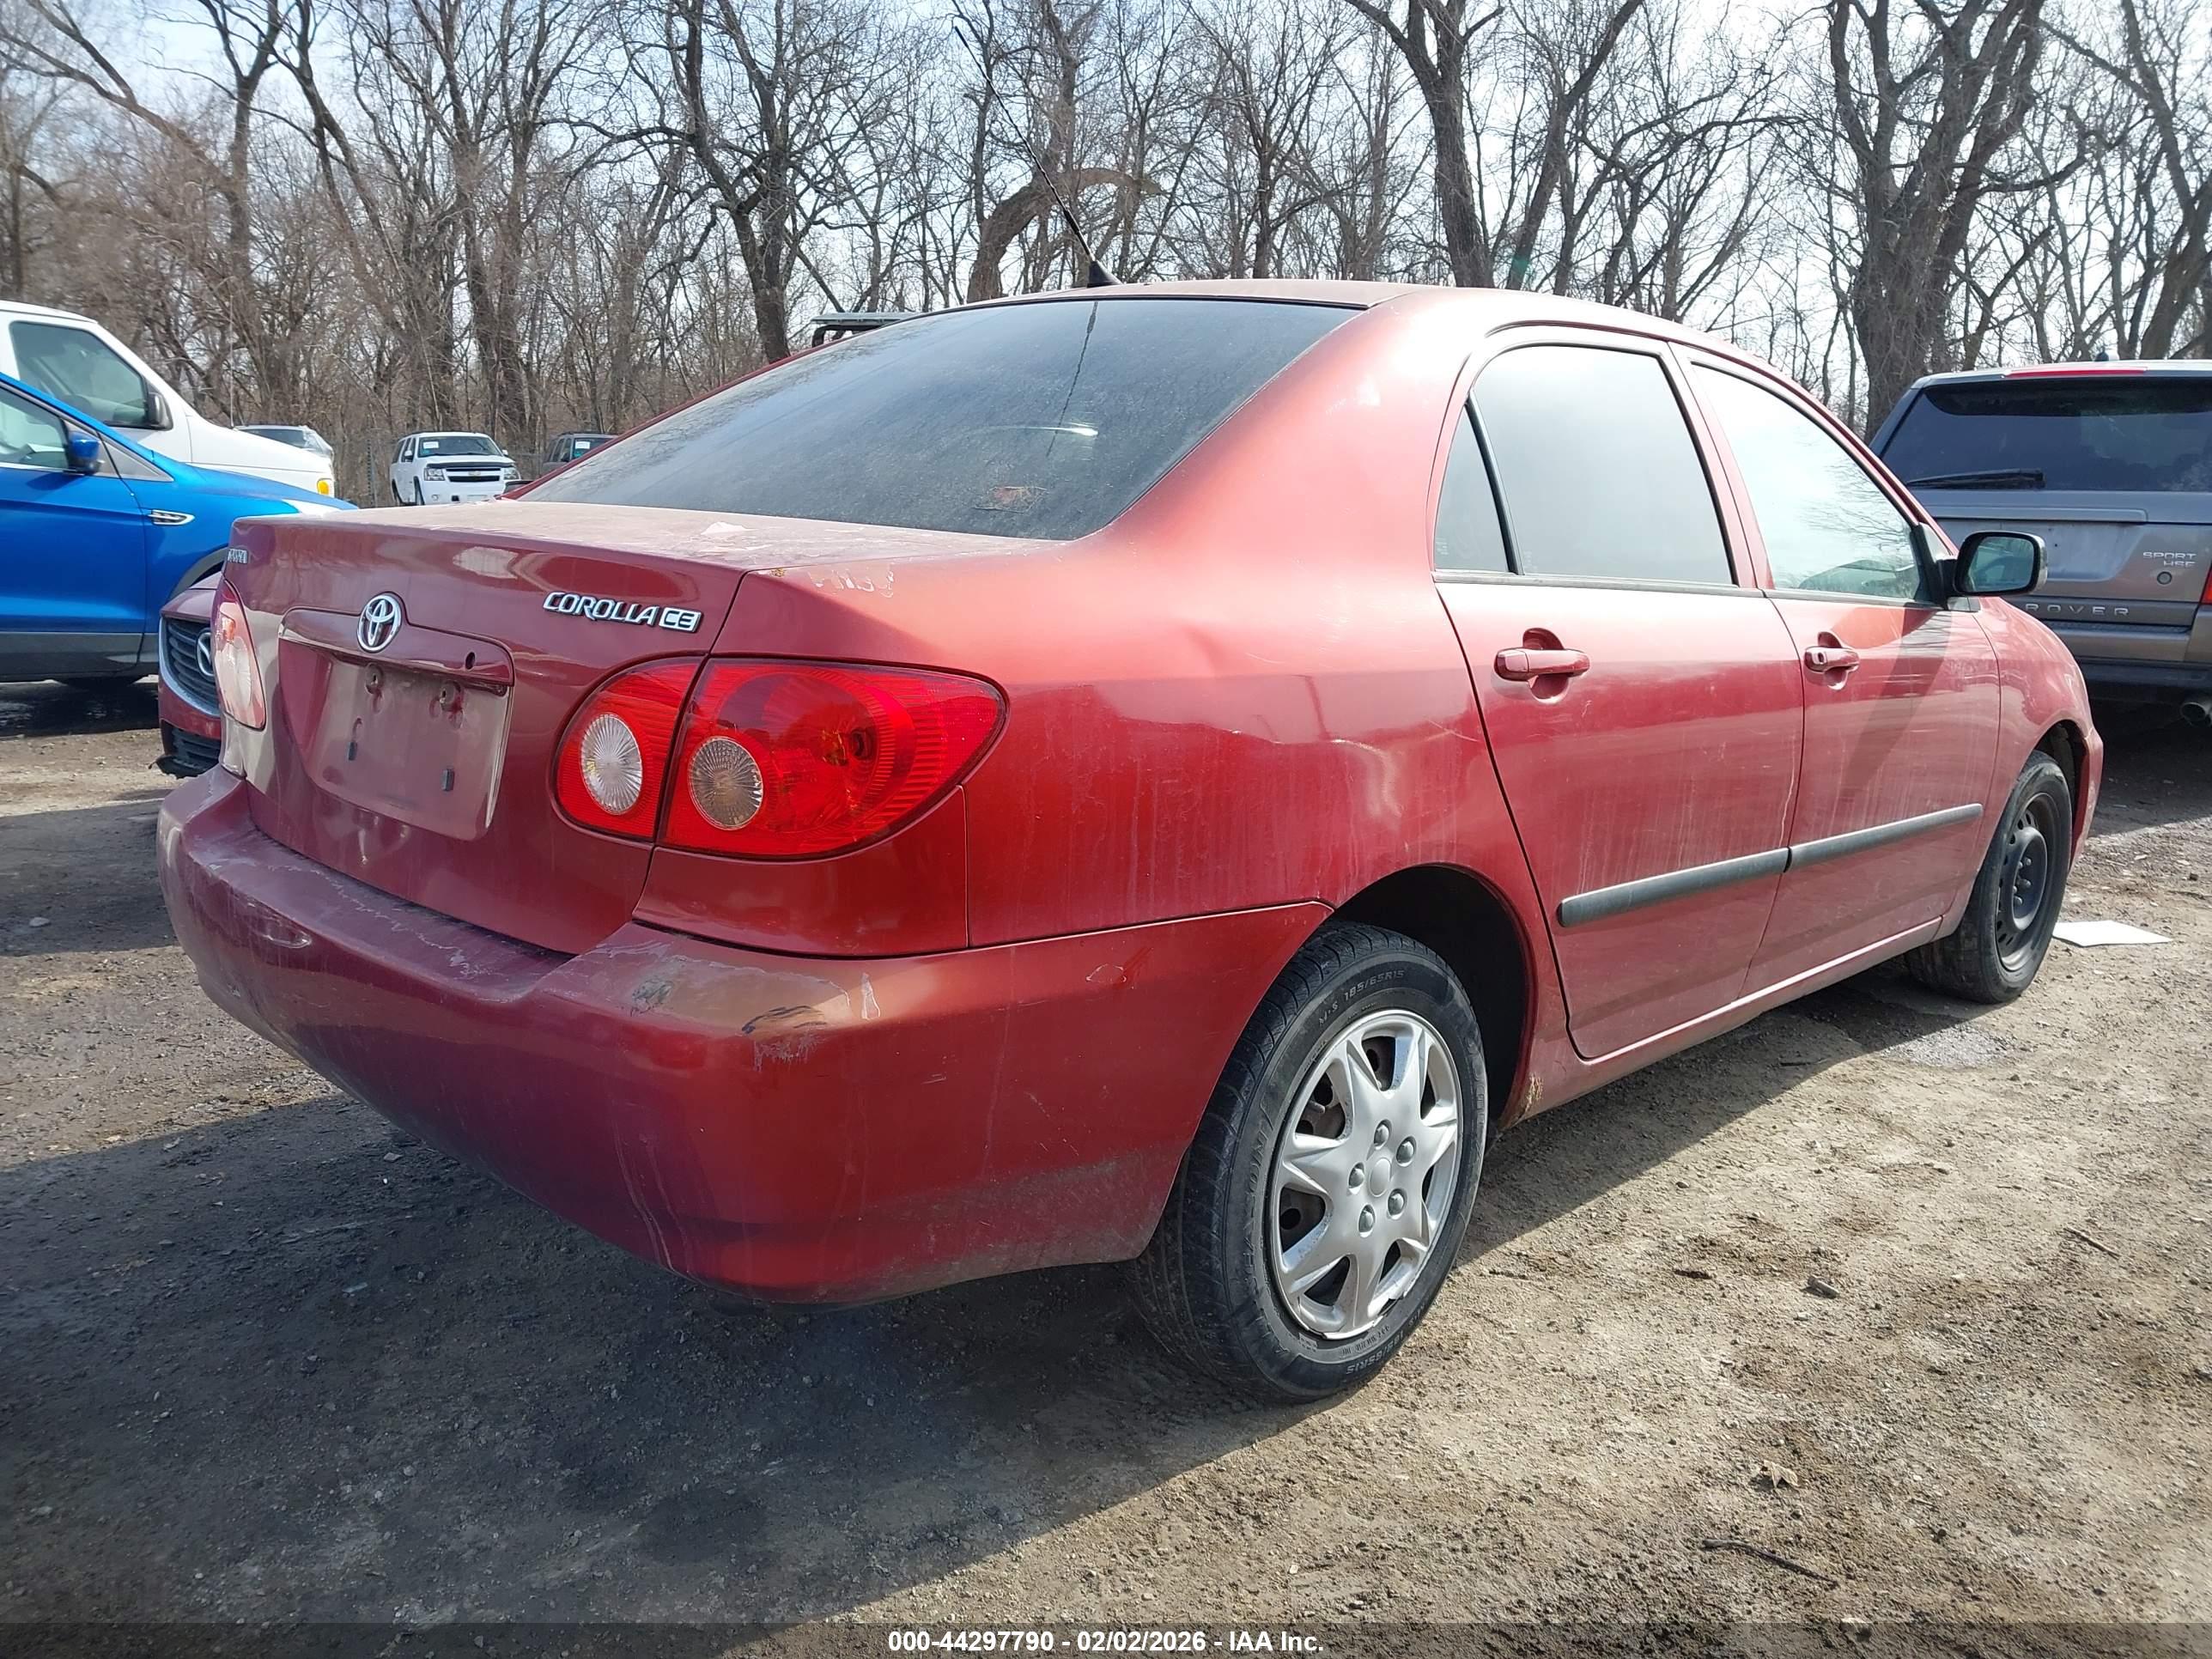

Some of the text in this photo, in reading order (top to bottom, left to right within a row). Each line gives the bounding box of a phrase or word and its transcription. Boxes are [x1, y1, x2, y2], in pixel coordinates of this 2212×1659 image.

[2142, 551, 2197, 560] SPORT
[543, 592, 697, 629] COROLLA CE
[2025, 603, 2130, 617] ROVER
[1344, 969, 1405, 1000] 185/65R15
